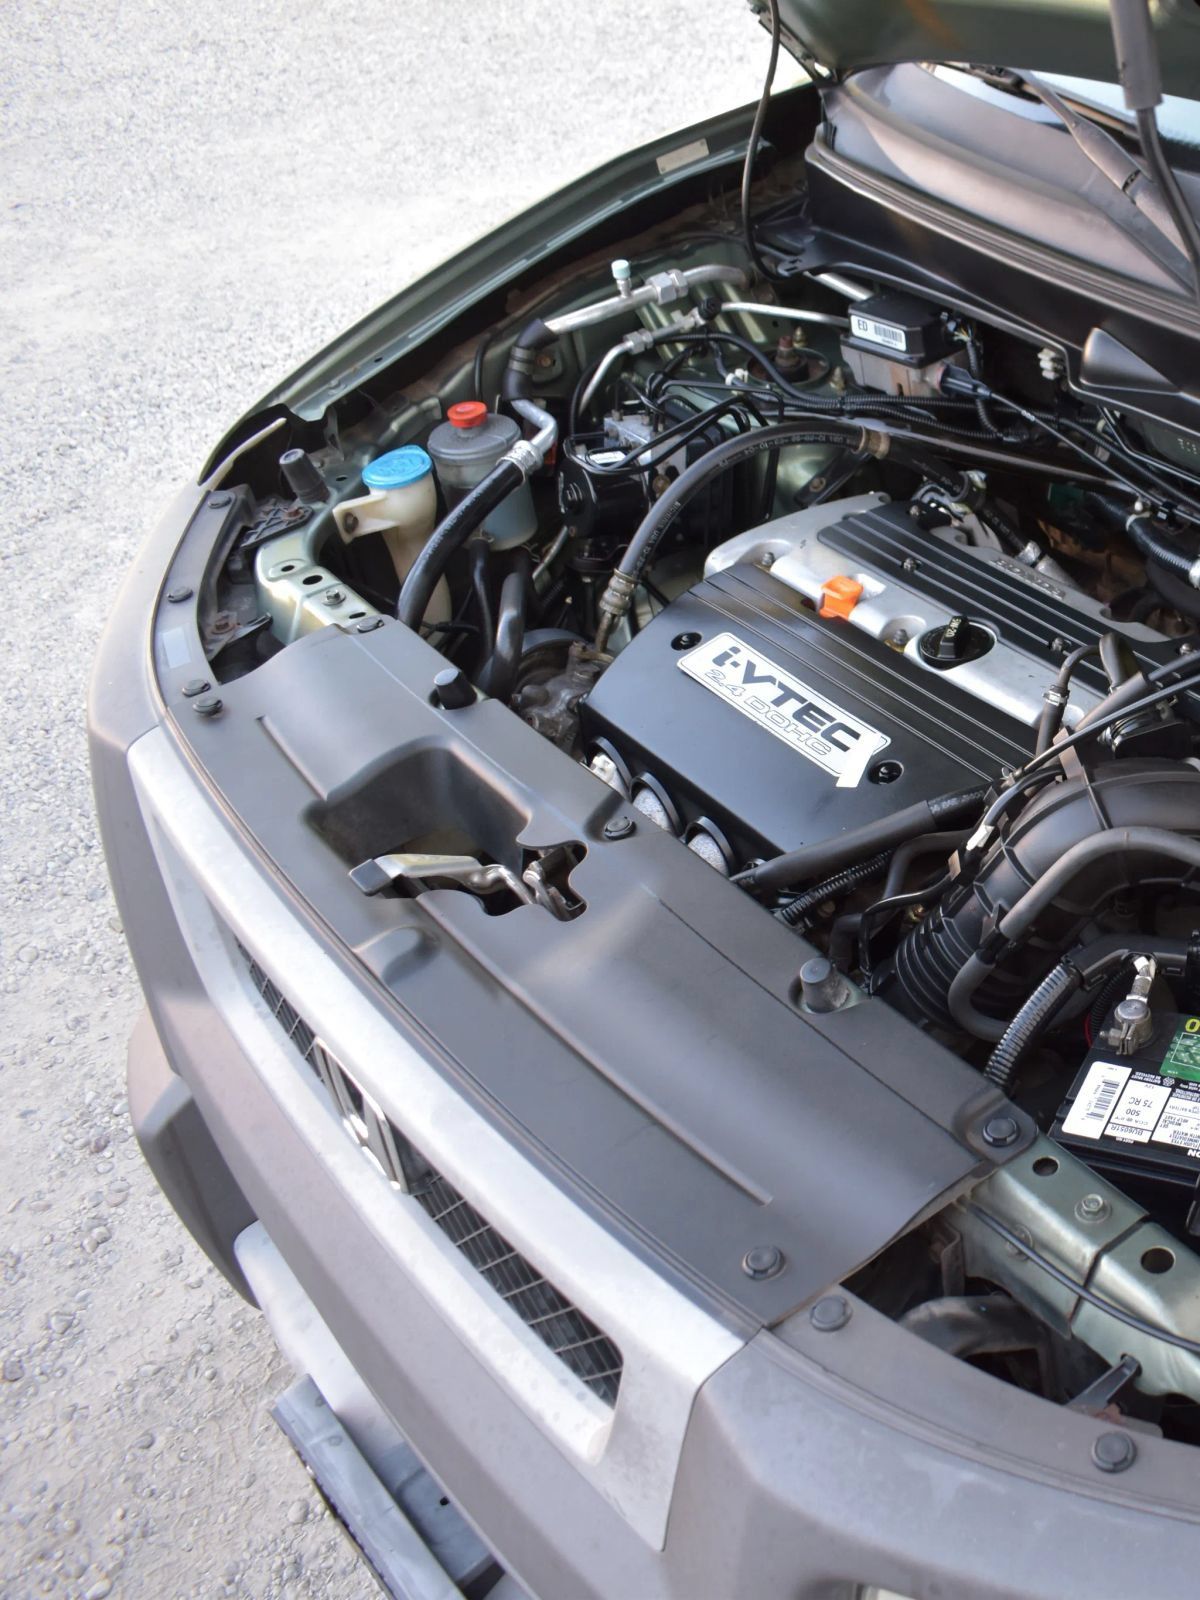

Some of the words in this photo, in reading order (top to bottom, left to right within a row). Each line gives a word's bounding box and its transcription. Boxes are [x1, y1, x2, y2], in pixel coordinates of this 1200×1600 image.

[857, 319, 868, 331] ED
[712, 646, 860, 752] i-VTEC
[704, 669, 745, 697] 2.4
[744, 696, 831, 756] DOHC
[1128, 1096, 1141, 1105] RC
[1142, 1099, 1153, 1107] 75
[1125, 1108, 1140, 1116] 500
